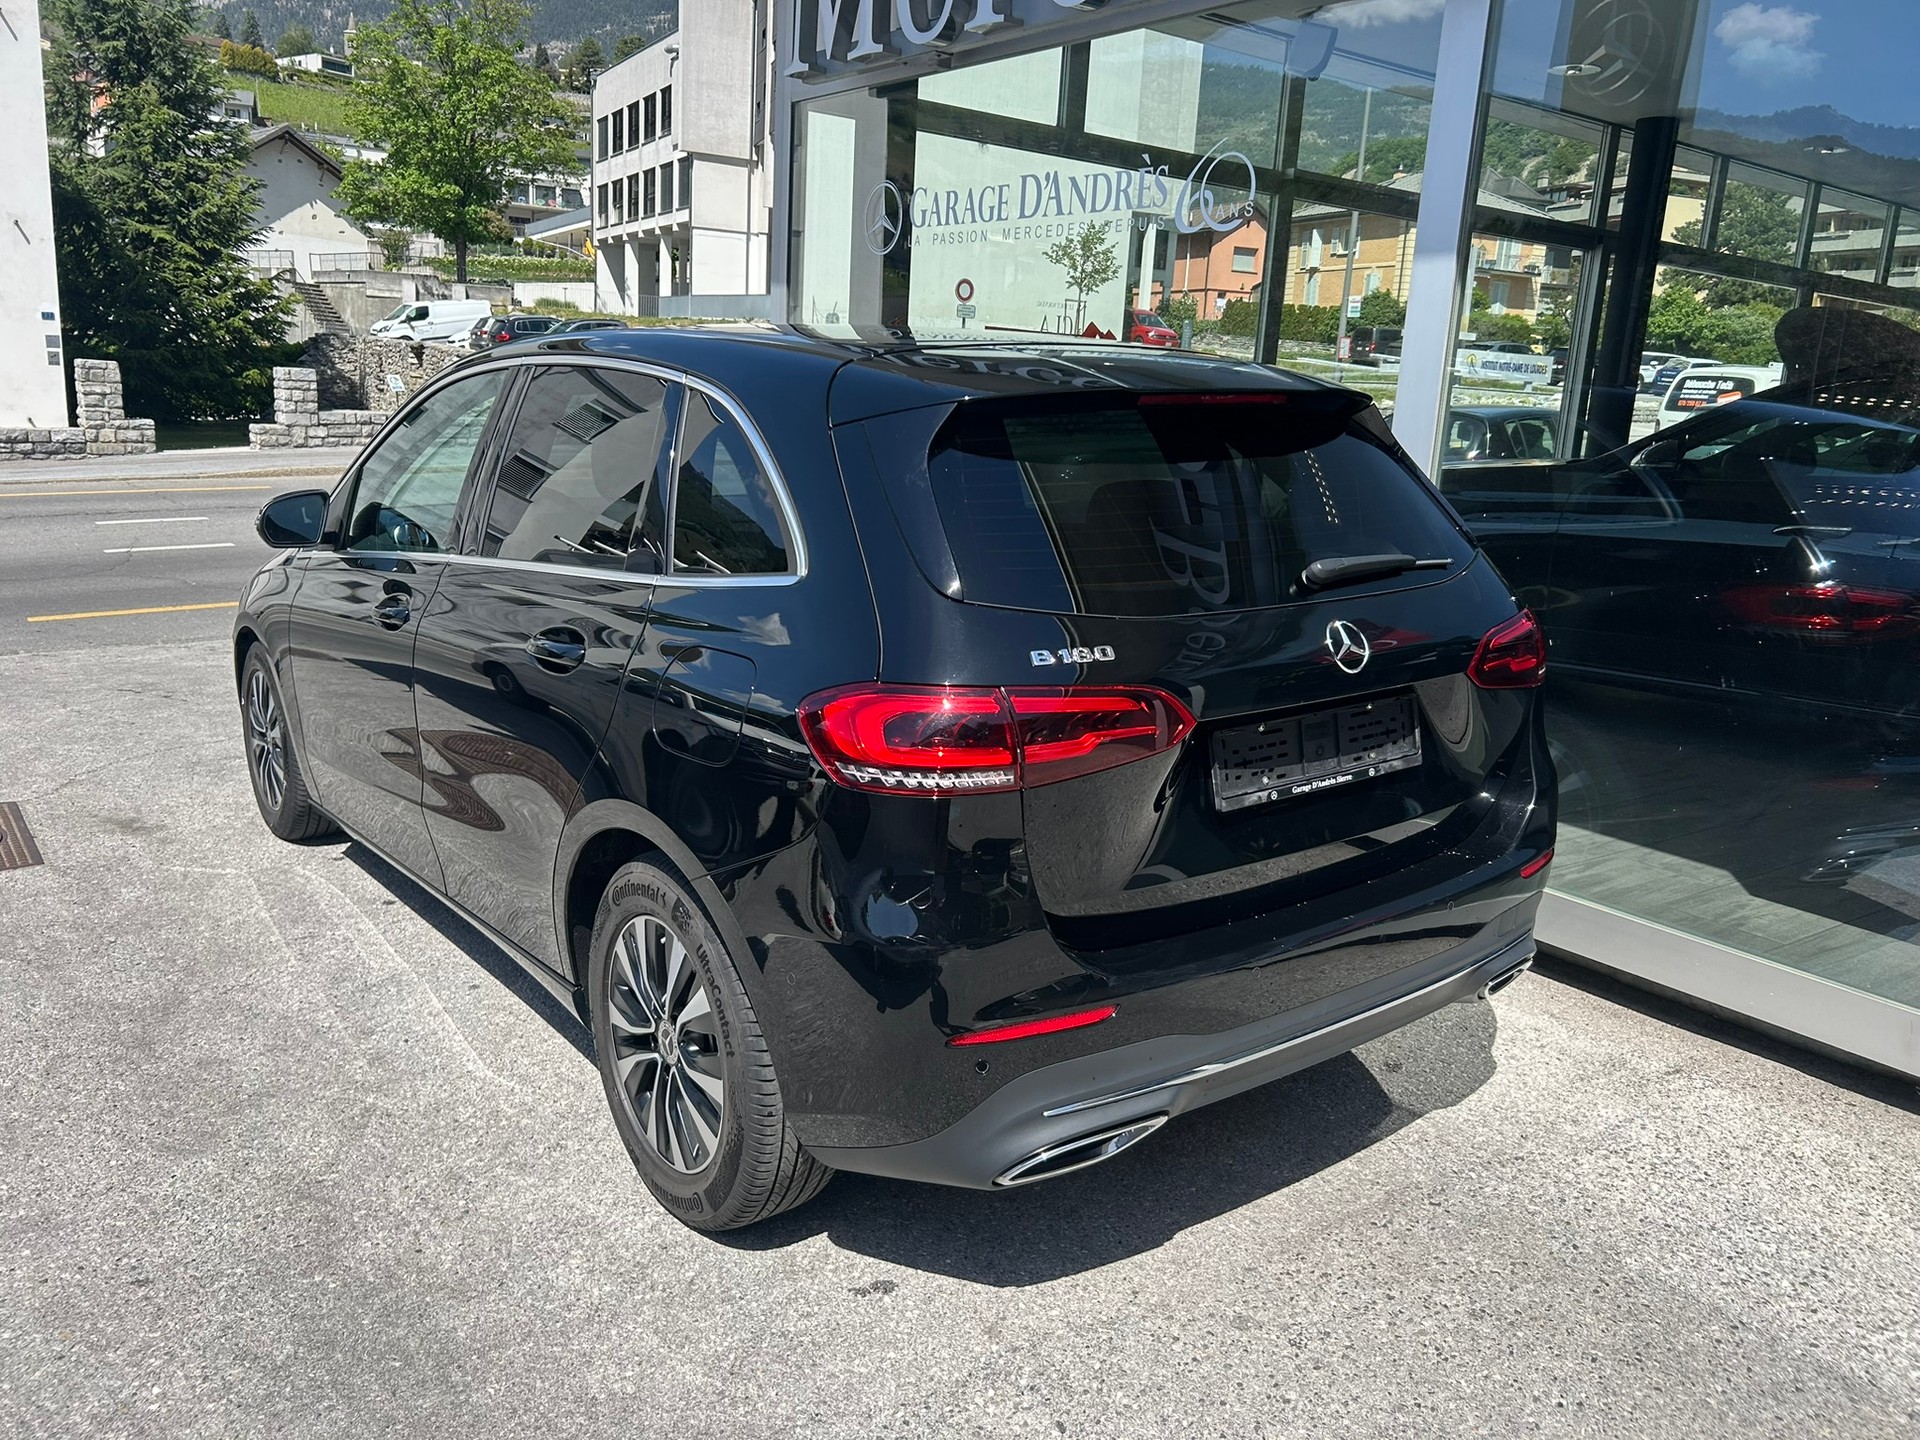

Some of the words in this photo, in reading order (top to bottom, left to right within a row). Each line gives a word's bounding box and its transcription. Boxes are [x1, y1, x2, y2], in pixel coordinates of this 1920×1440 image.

[910, 184, 1010, 228] GARAGE
[1017, 153, 1169, 220] D'ANDRÈS
[907, 235, 921, 248] LA
[933, 229, 988, 246] PASSION
[1002, 222, 1086, 241] MERCEDES
[1103, 216, 1165, 234] DEPUIS
[1215, 201, 1255, 218] ANS
[1292, 783, 1311, 794] Garage
[1336, 774, 1353, 783] Sierre
[611, 879, 661, 907] Continental
[695, 943, 735, 1059] UltraContact
